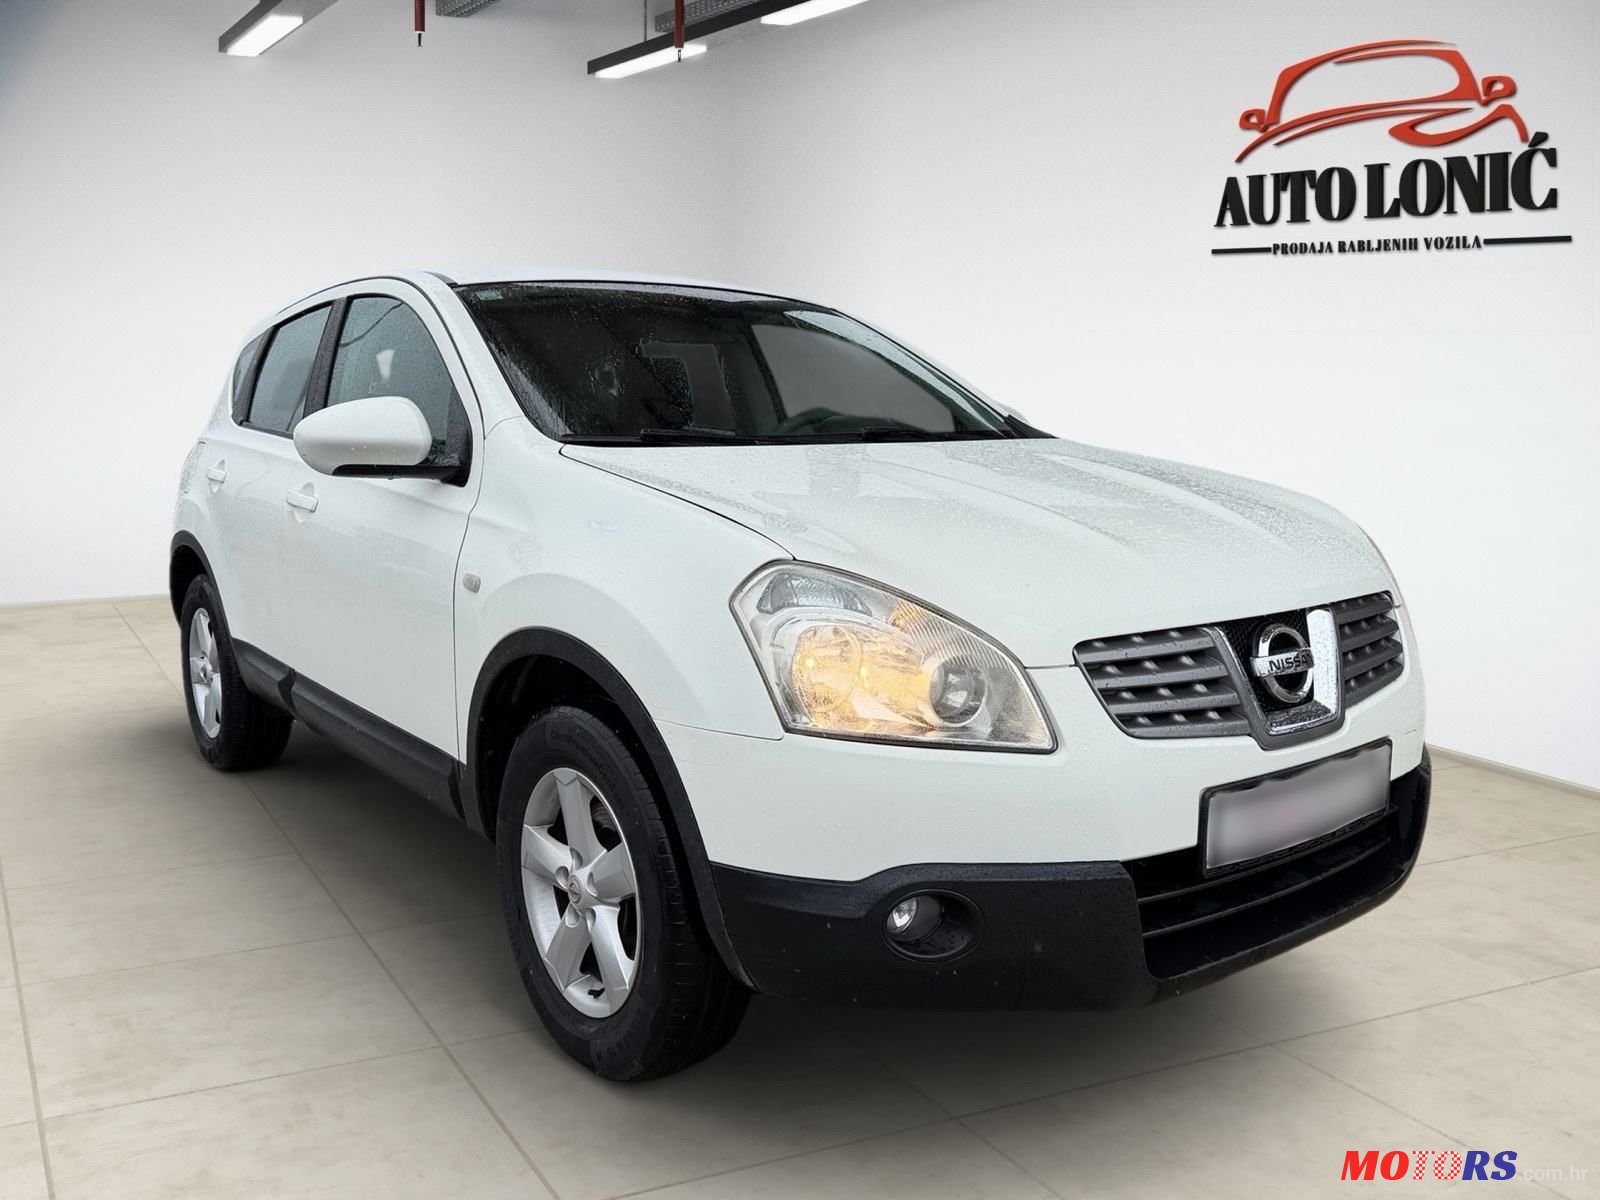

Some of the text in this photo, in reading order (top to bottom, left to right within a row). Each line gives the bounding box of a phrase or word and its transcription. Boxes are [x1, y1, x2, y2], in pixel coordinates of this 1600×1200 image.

[1214, 132, 1557, 227] AUTO LONIĆ
[1273, 236, 1481, 255] PRODAJA RABLJENIH VOZILA
